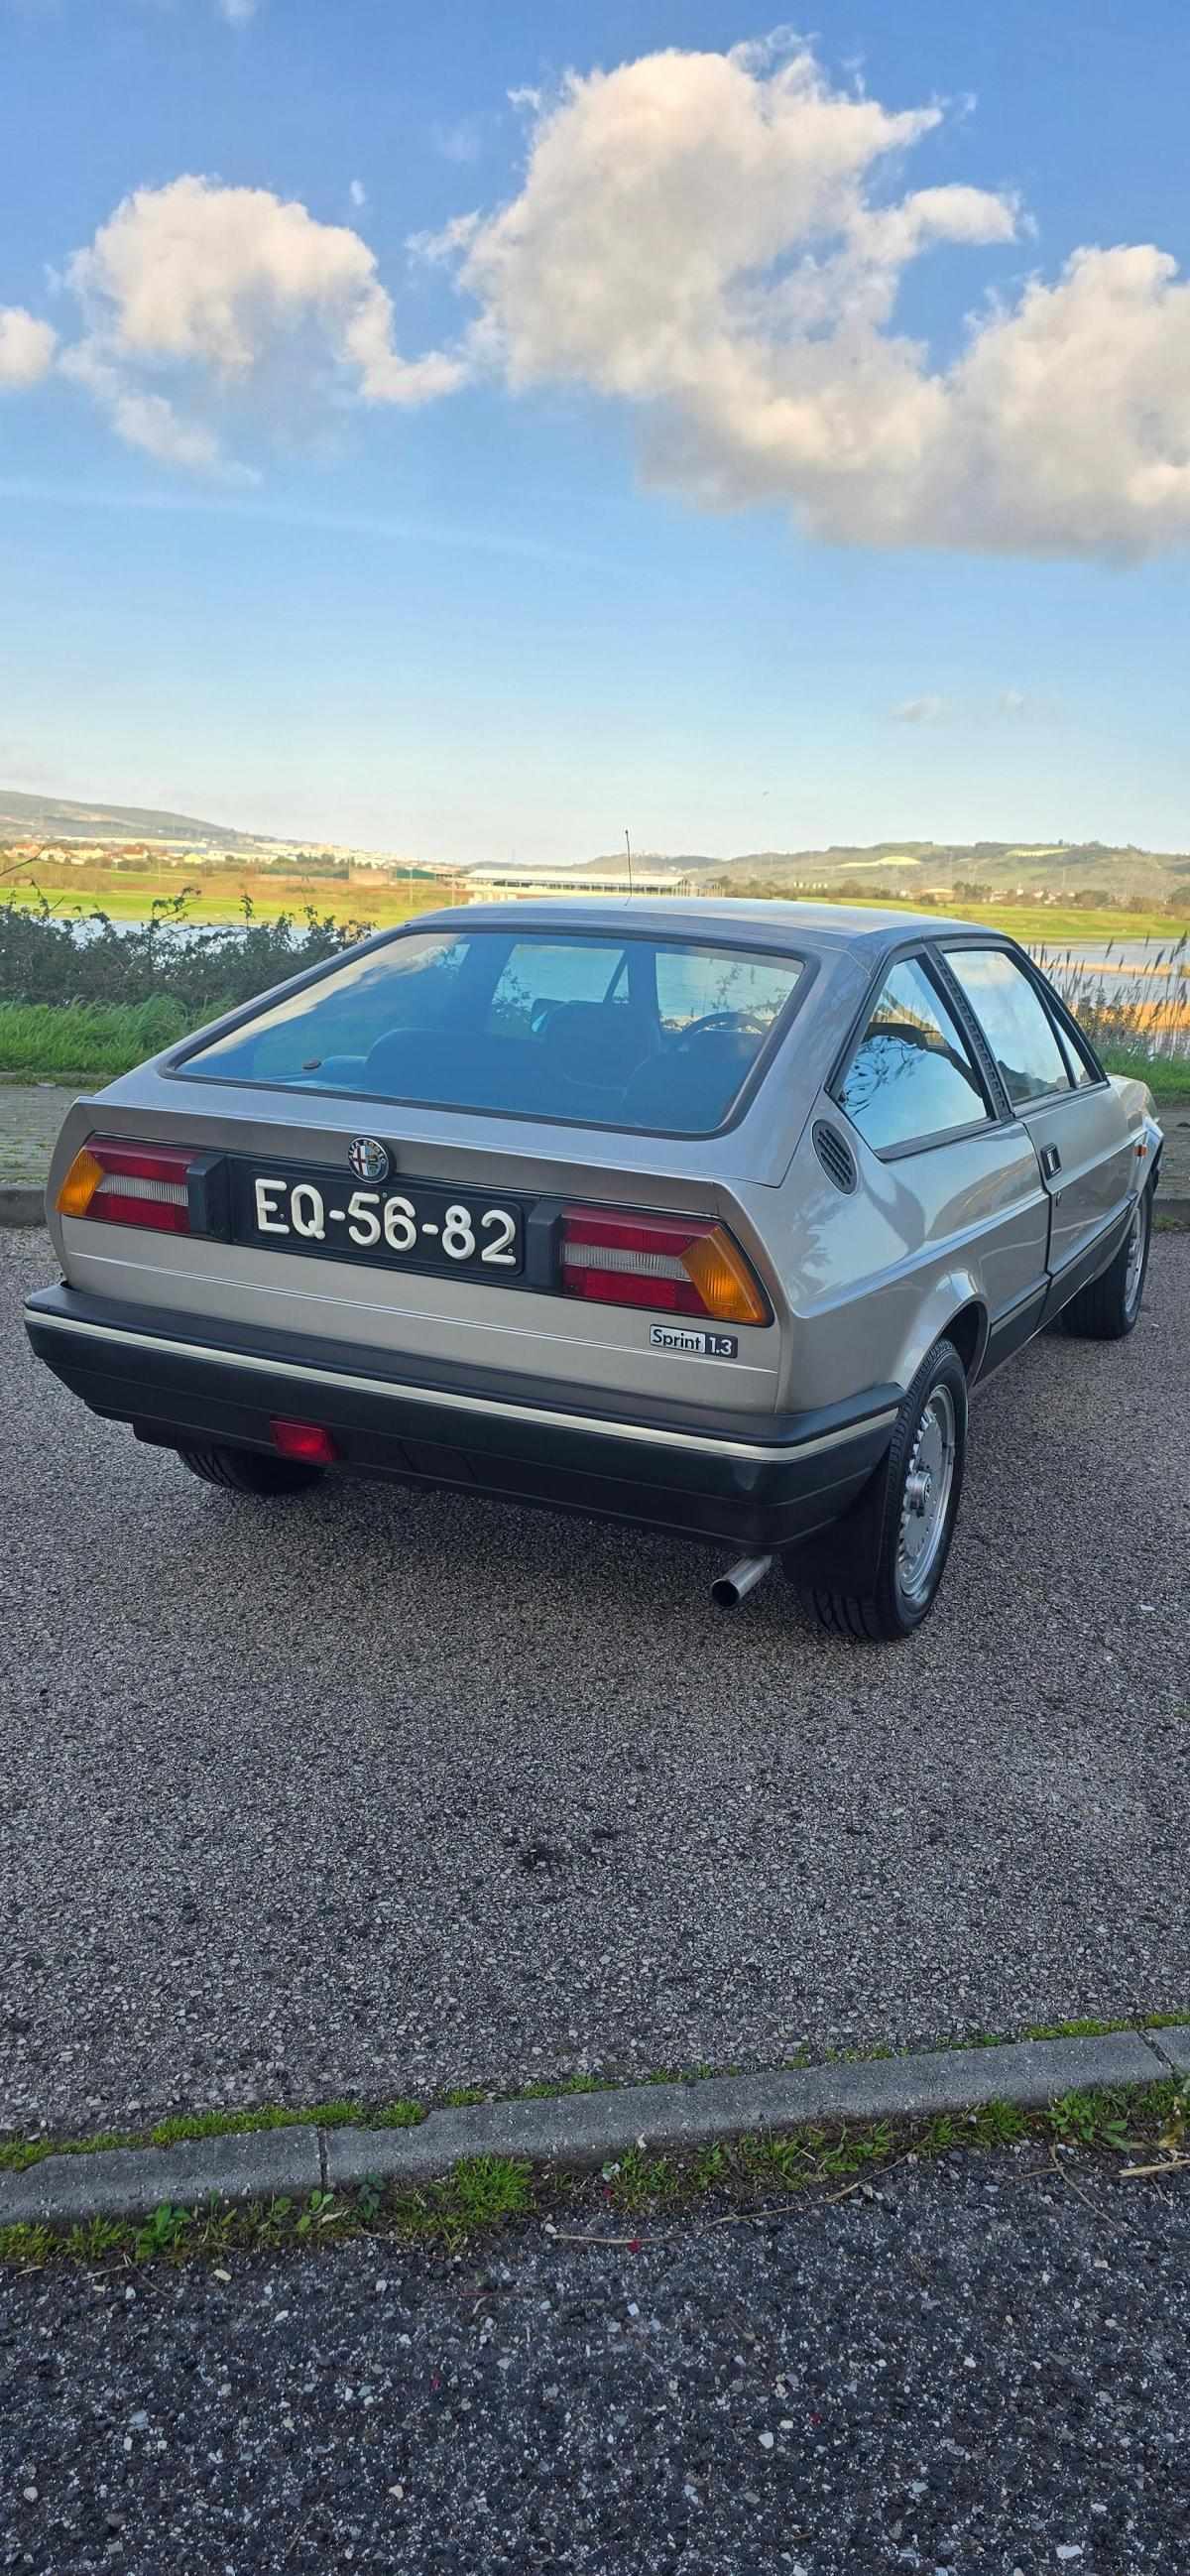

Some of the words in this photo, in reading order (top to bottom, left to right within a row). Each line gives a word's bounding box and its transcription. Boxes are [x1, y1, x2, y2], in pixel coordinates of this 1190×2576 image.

[255, 1178, 517, 1266] EQ-56-82
[653, 1328, 701, 1350] Sprint
[709, 1336, 733, 1356] 1.3
